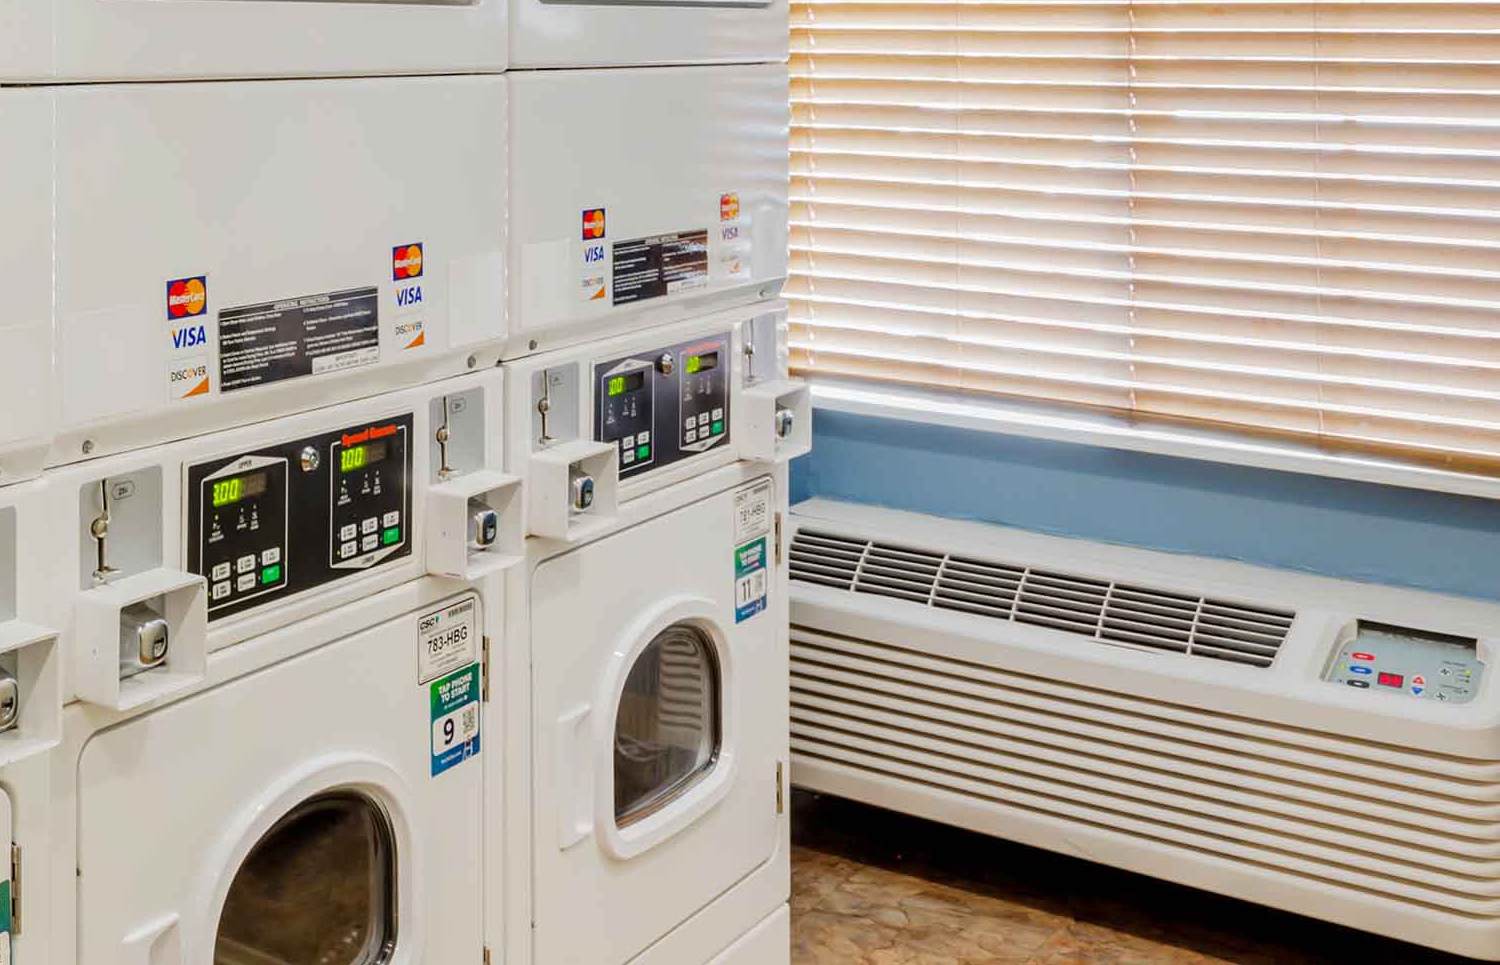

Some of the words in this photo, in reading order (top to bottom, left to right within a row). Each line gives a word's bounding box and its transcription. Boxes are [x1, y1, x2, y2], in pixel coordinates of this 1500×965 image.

[584, 246, 604, 263] VISA
[396, 286, 422, 306] VISA
[172, 325, 206, 348] VISA
[171, 365, 206, 382] DISCOVER
[419, 617, 435, 630] CSC
[427, 625, 468, 653] 783-HBG
[443, 718, 455, 745] 9
